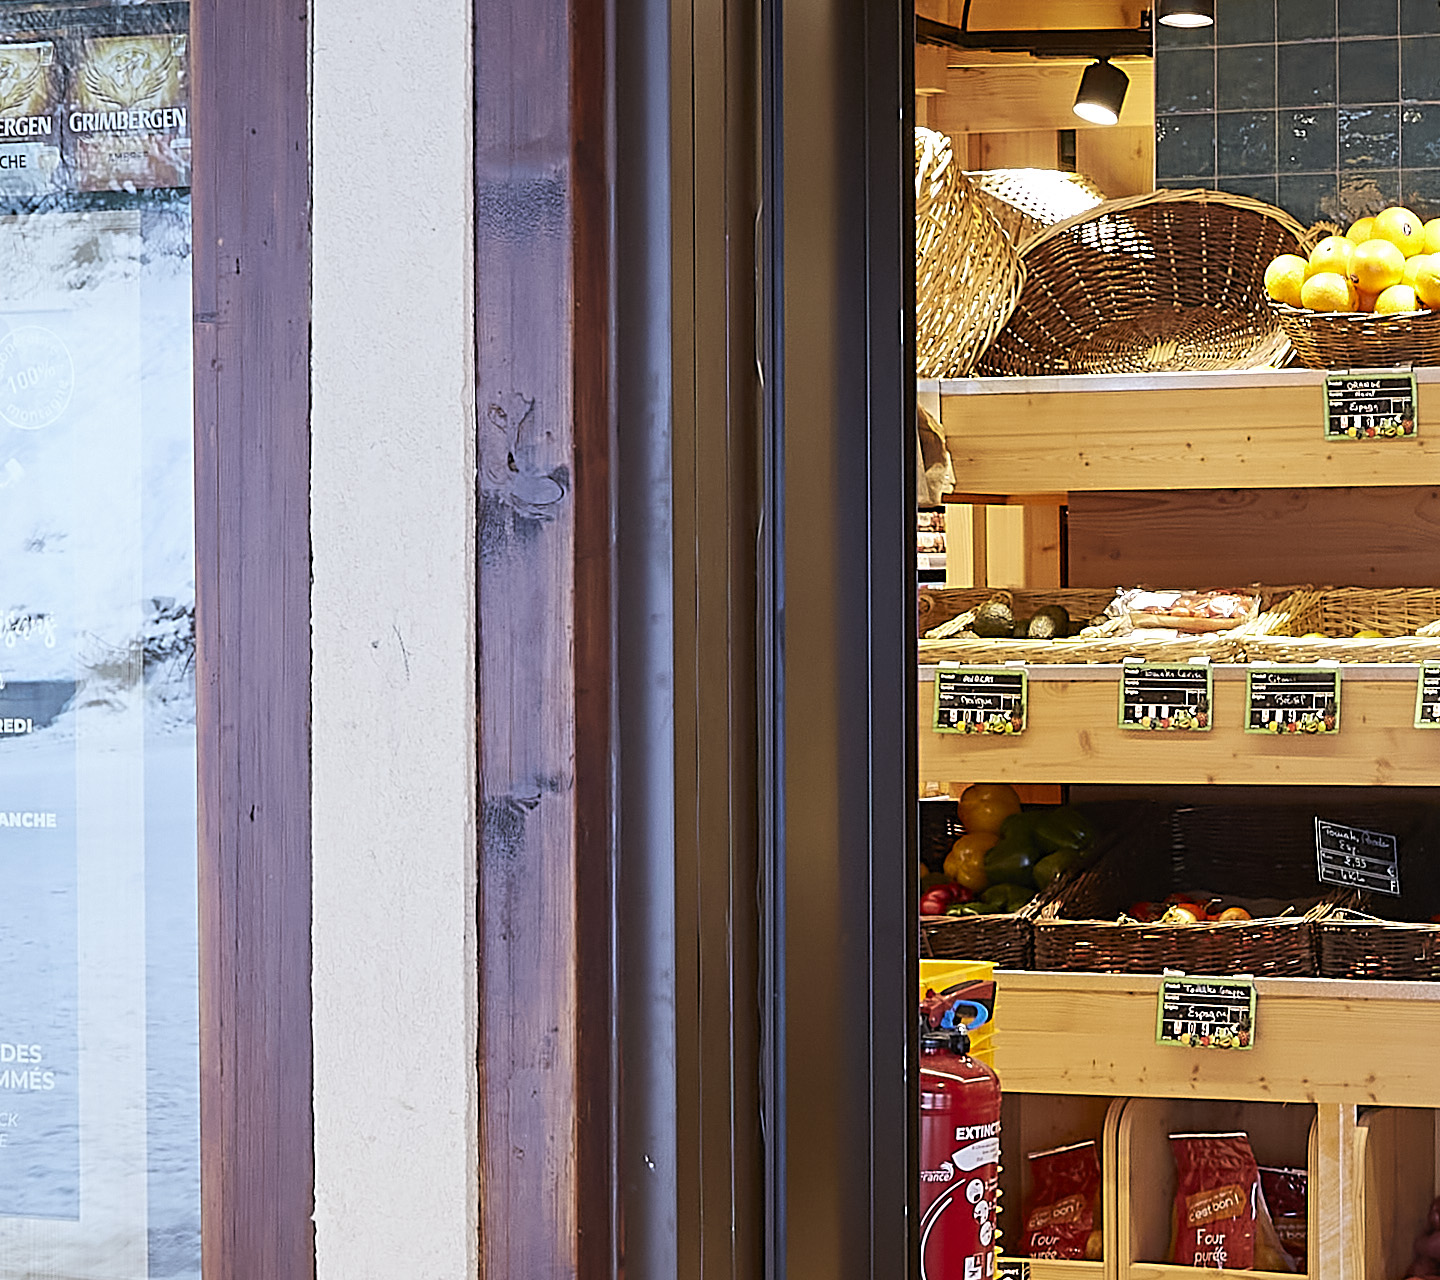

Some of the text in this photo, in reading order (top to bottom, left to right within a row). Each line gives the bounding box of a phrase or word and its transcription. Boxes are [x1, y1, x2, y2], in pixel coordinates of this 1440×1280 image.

[68, 107, 188, 134] GRIMBERGEN
[1, 1044, 42, 1063] DES
[921, 1171, 951, 1182] rance
[1212, 1197, 1234, 1212] bon
[1197, 1228, 1226, 1246] Four
